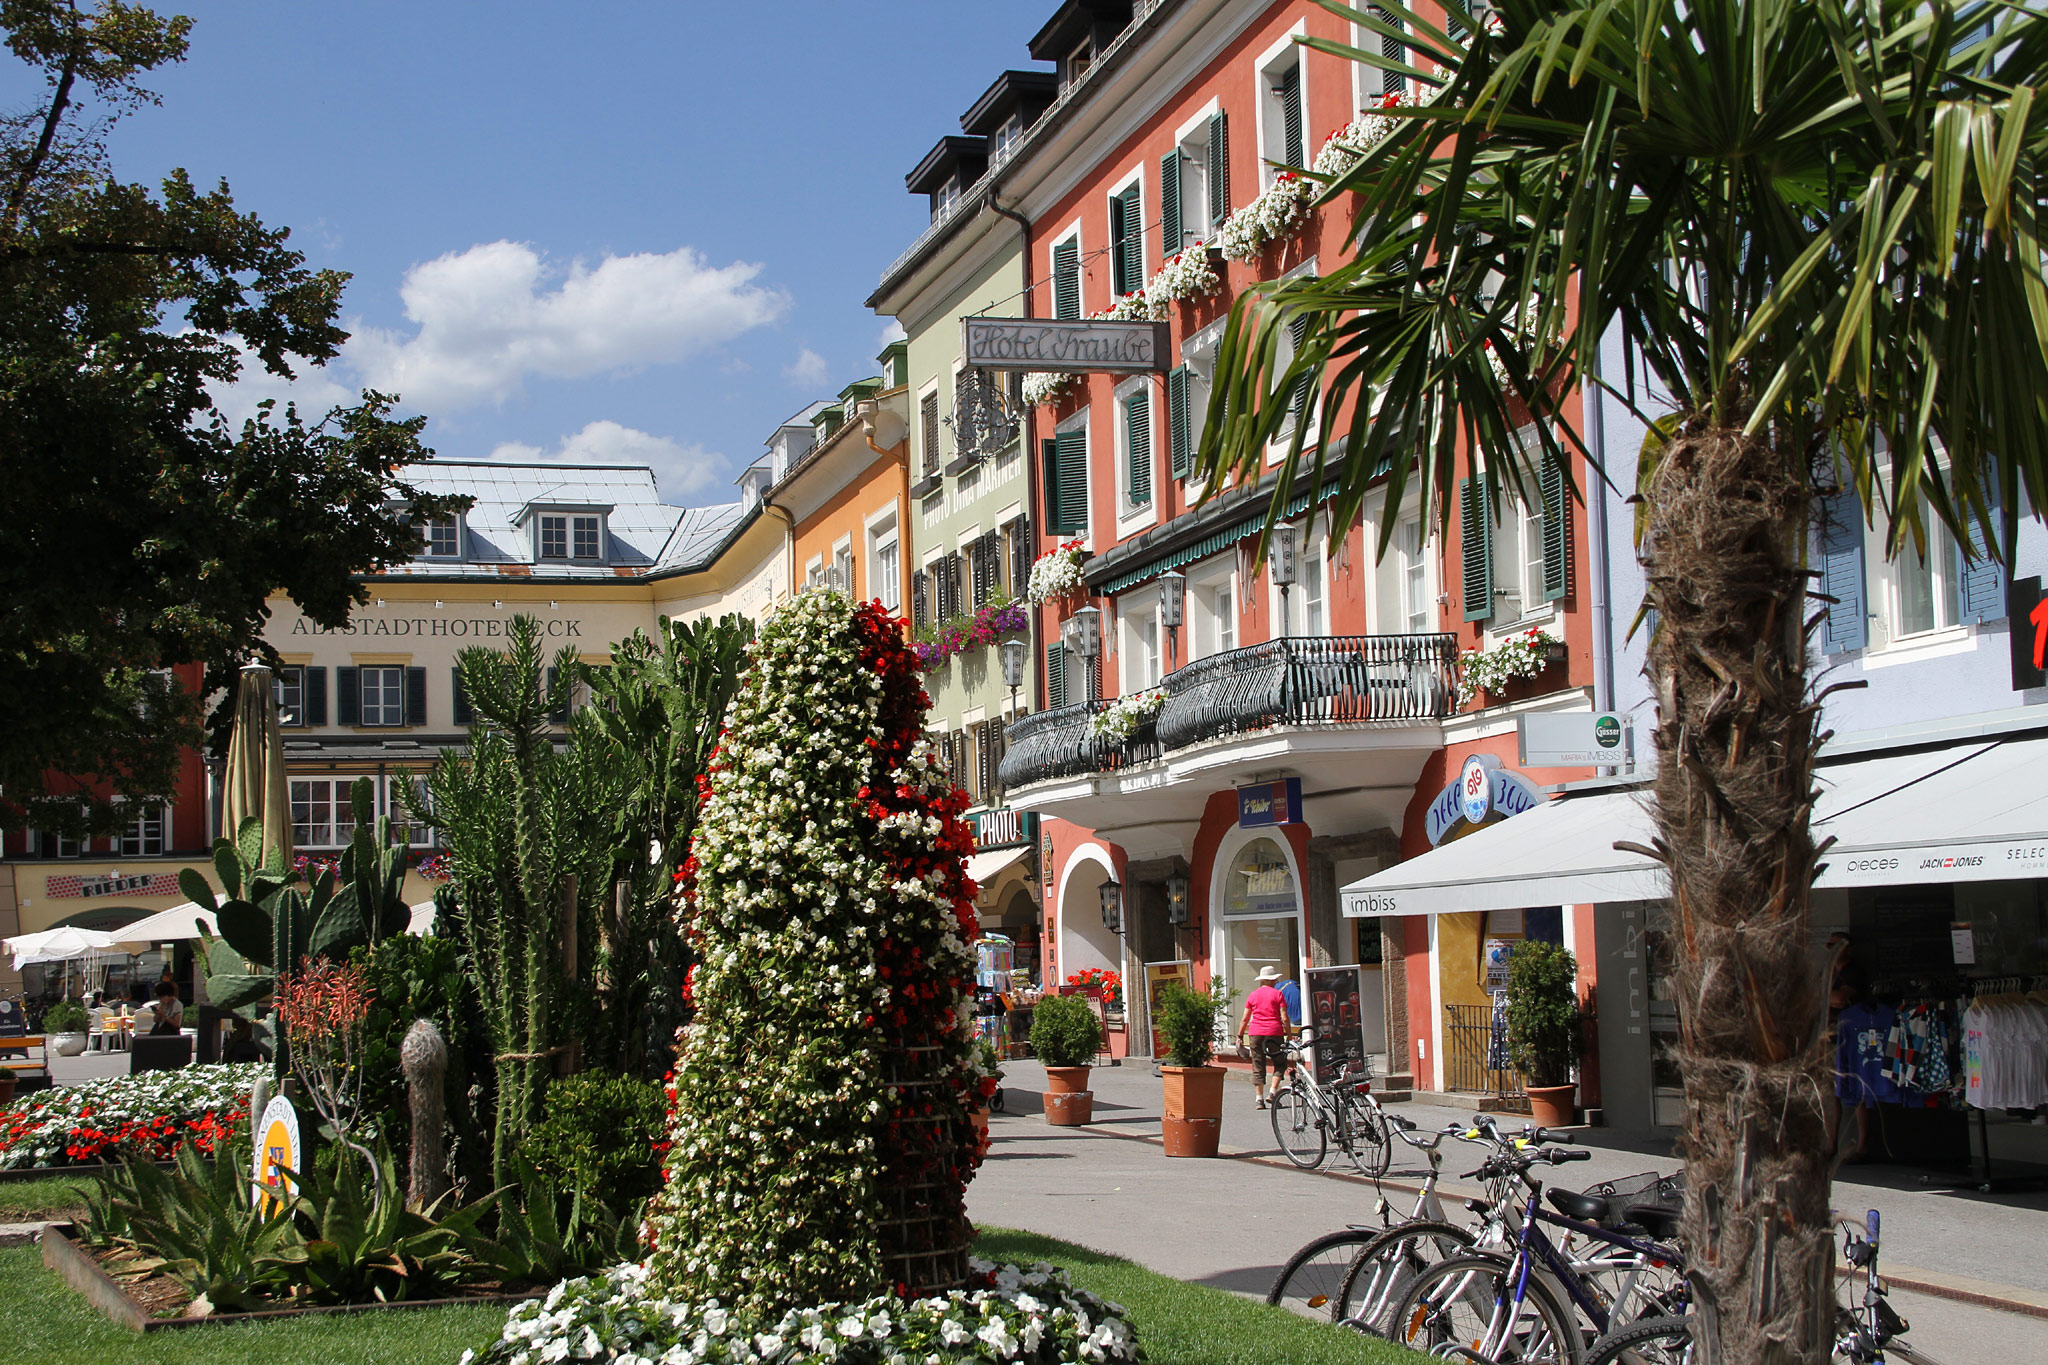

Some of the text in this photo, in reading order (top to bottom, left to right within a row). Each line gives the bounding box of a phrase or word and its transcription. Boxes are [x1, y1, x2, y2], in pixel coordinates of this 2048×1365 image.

[974, 324, 1151, 362] Hotel Traube
[924, 493, 951, 531] PHOTO
[953, 476, 975, 514] DINA
[1587, 750, 1621, 761] IMBISS
[1496, 778, 1535, 815] BLU
[980, 809, 1017, 846] PHOTO
[1919, 855, 1983, 870] JACK JONES
[2006, 847, 2048, 860] SELEC
[1847, 857, 1899, 873] pieces
[82, 874, 154, 898] RIEDER
[1351, 894, 1396, 912] imbiss
